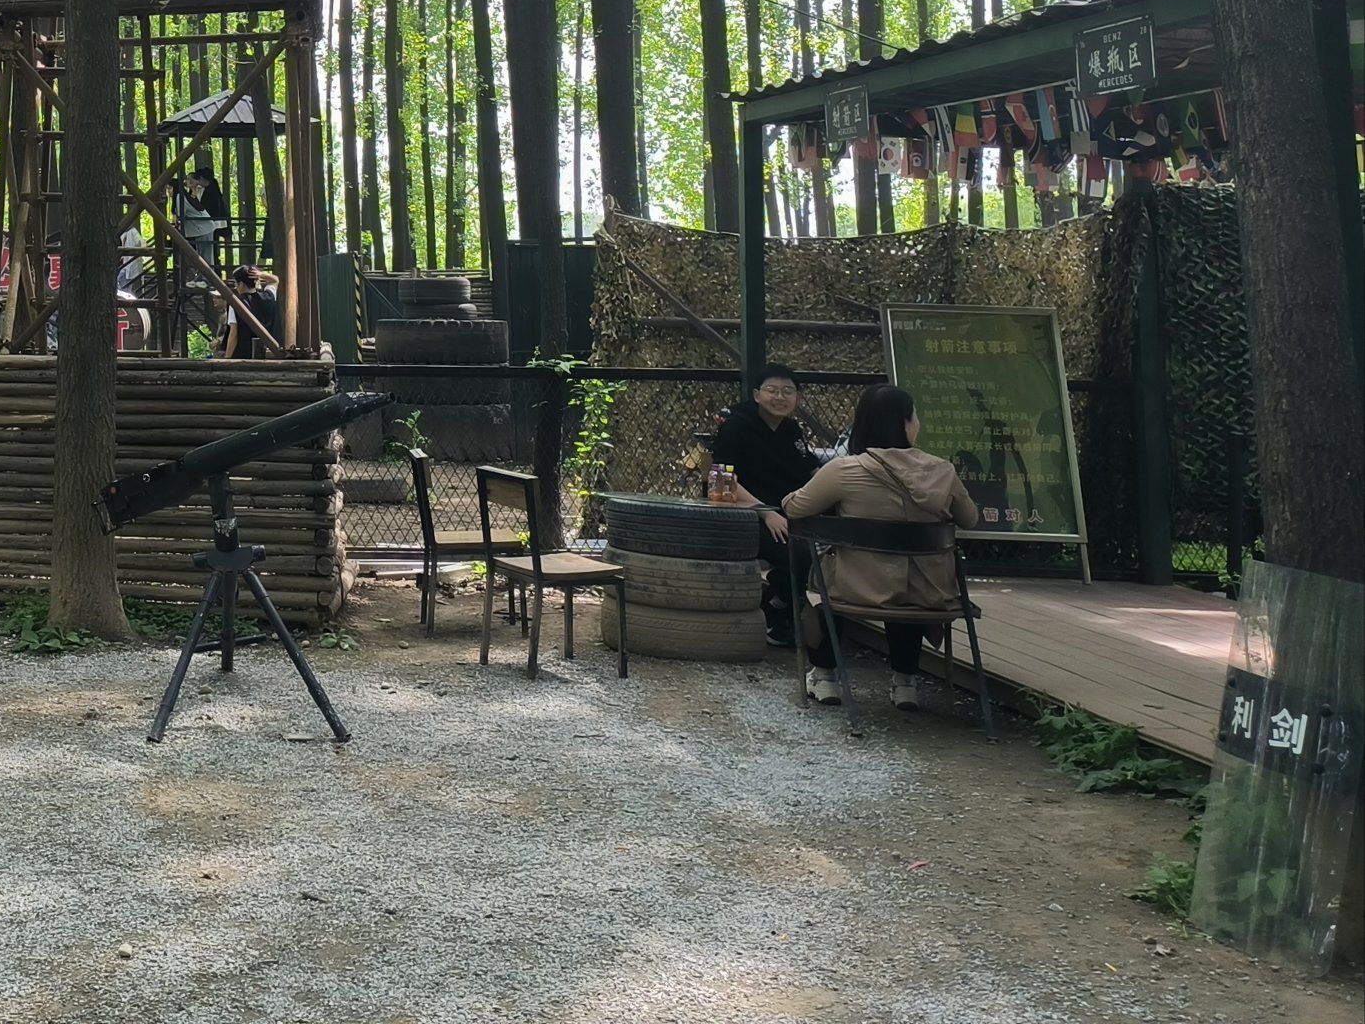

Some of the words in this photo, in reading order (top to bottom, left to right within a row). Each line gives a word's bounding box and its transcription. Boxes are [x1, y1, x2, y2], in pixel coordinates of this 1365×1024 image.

[1102, 31, 1122, 44] BENZ
[1098, 73, 1134, 89] MERCEDES
[924, 338, 1018, 354] 射箭注意事项
[1231, 695, 1309, 756] 利剑
